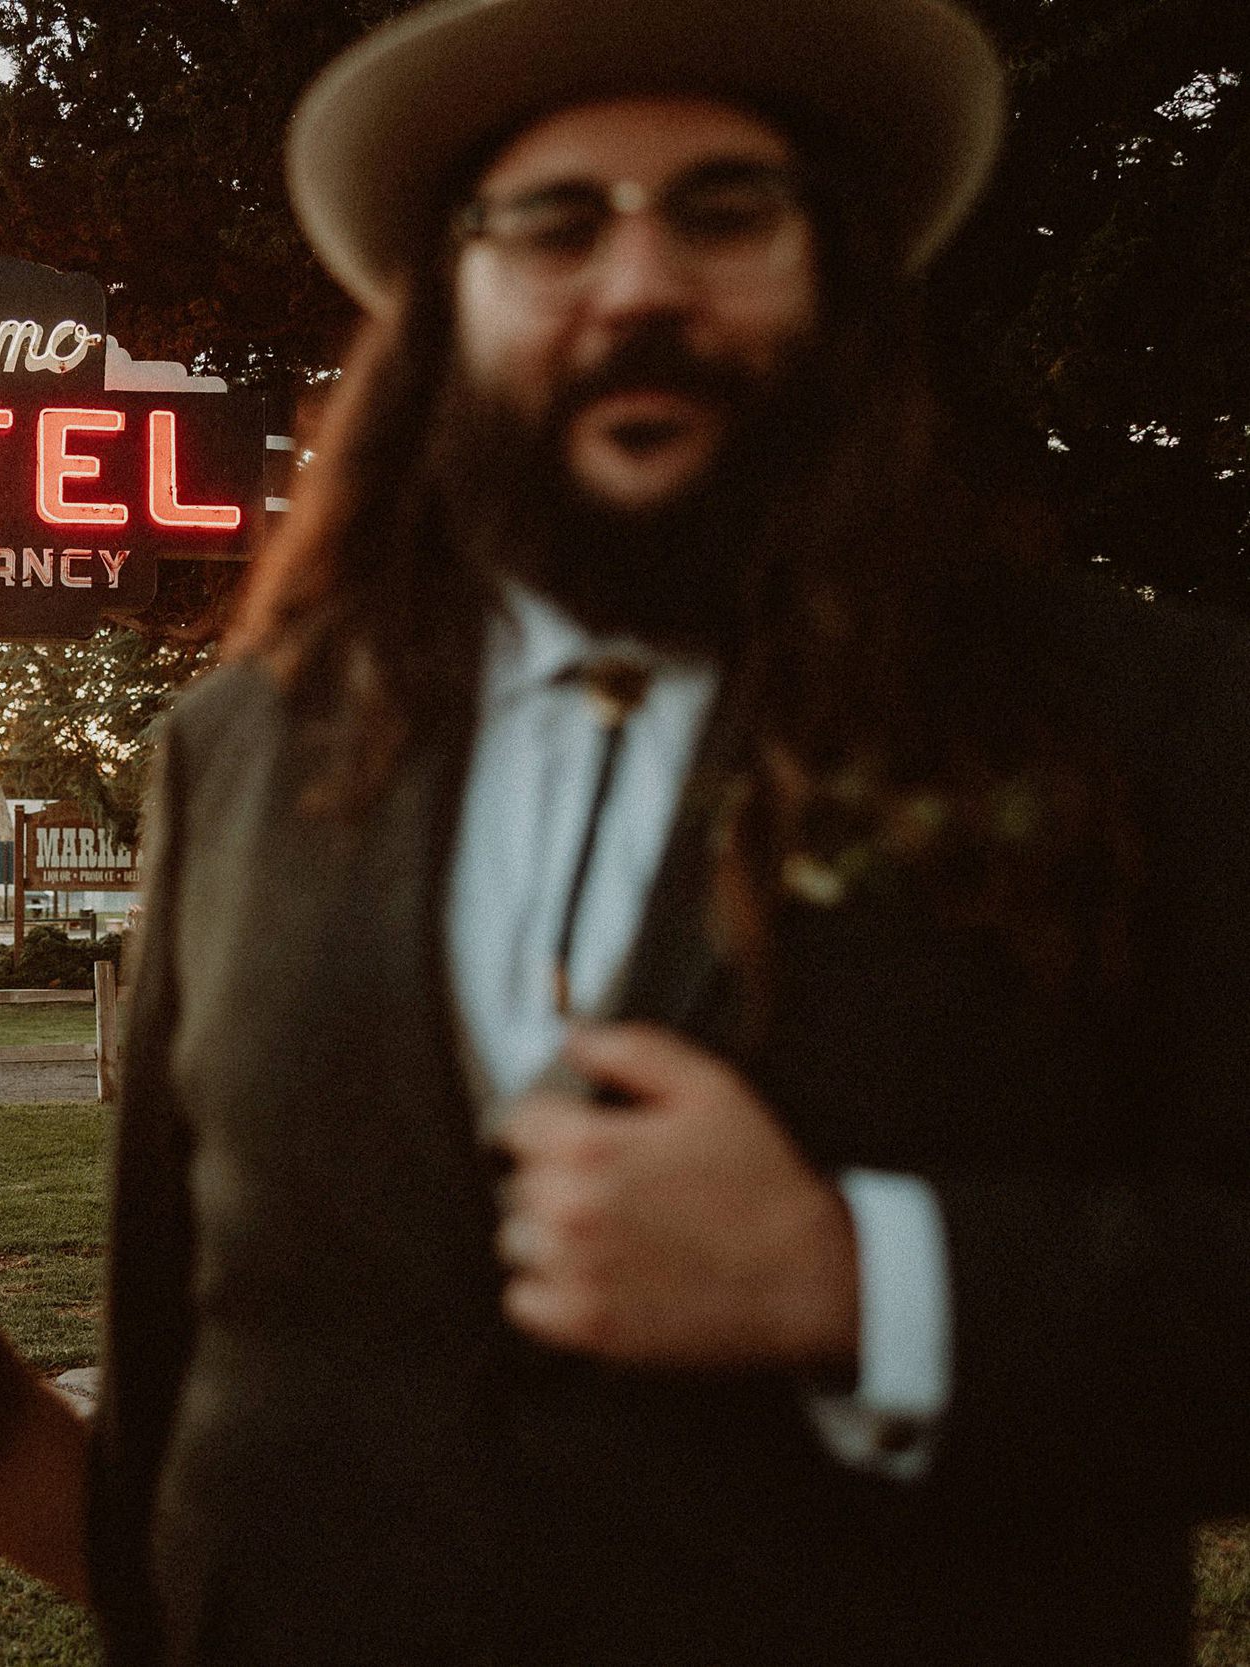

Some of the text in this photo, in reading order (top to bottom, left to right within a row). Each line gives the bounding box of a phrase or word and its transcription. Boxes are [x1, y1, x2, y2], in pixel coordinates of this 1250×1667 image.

[43, 870, 140, 884] LIQUOR PRODUCE DELI
